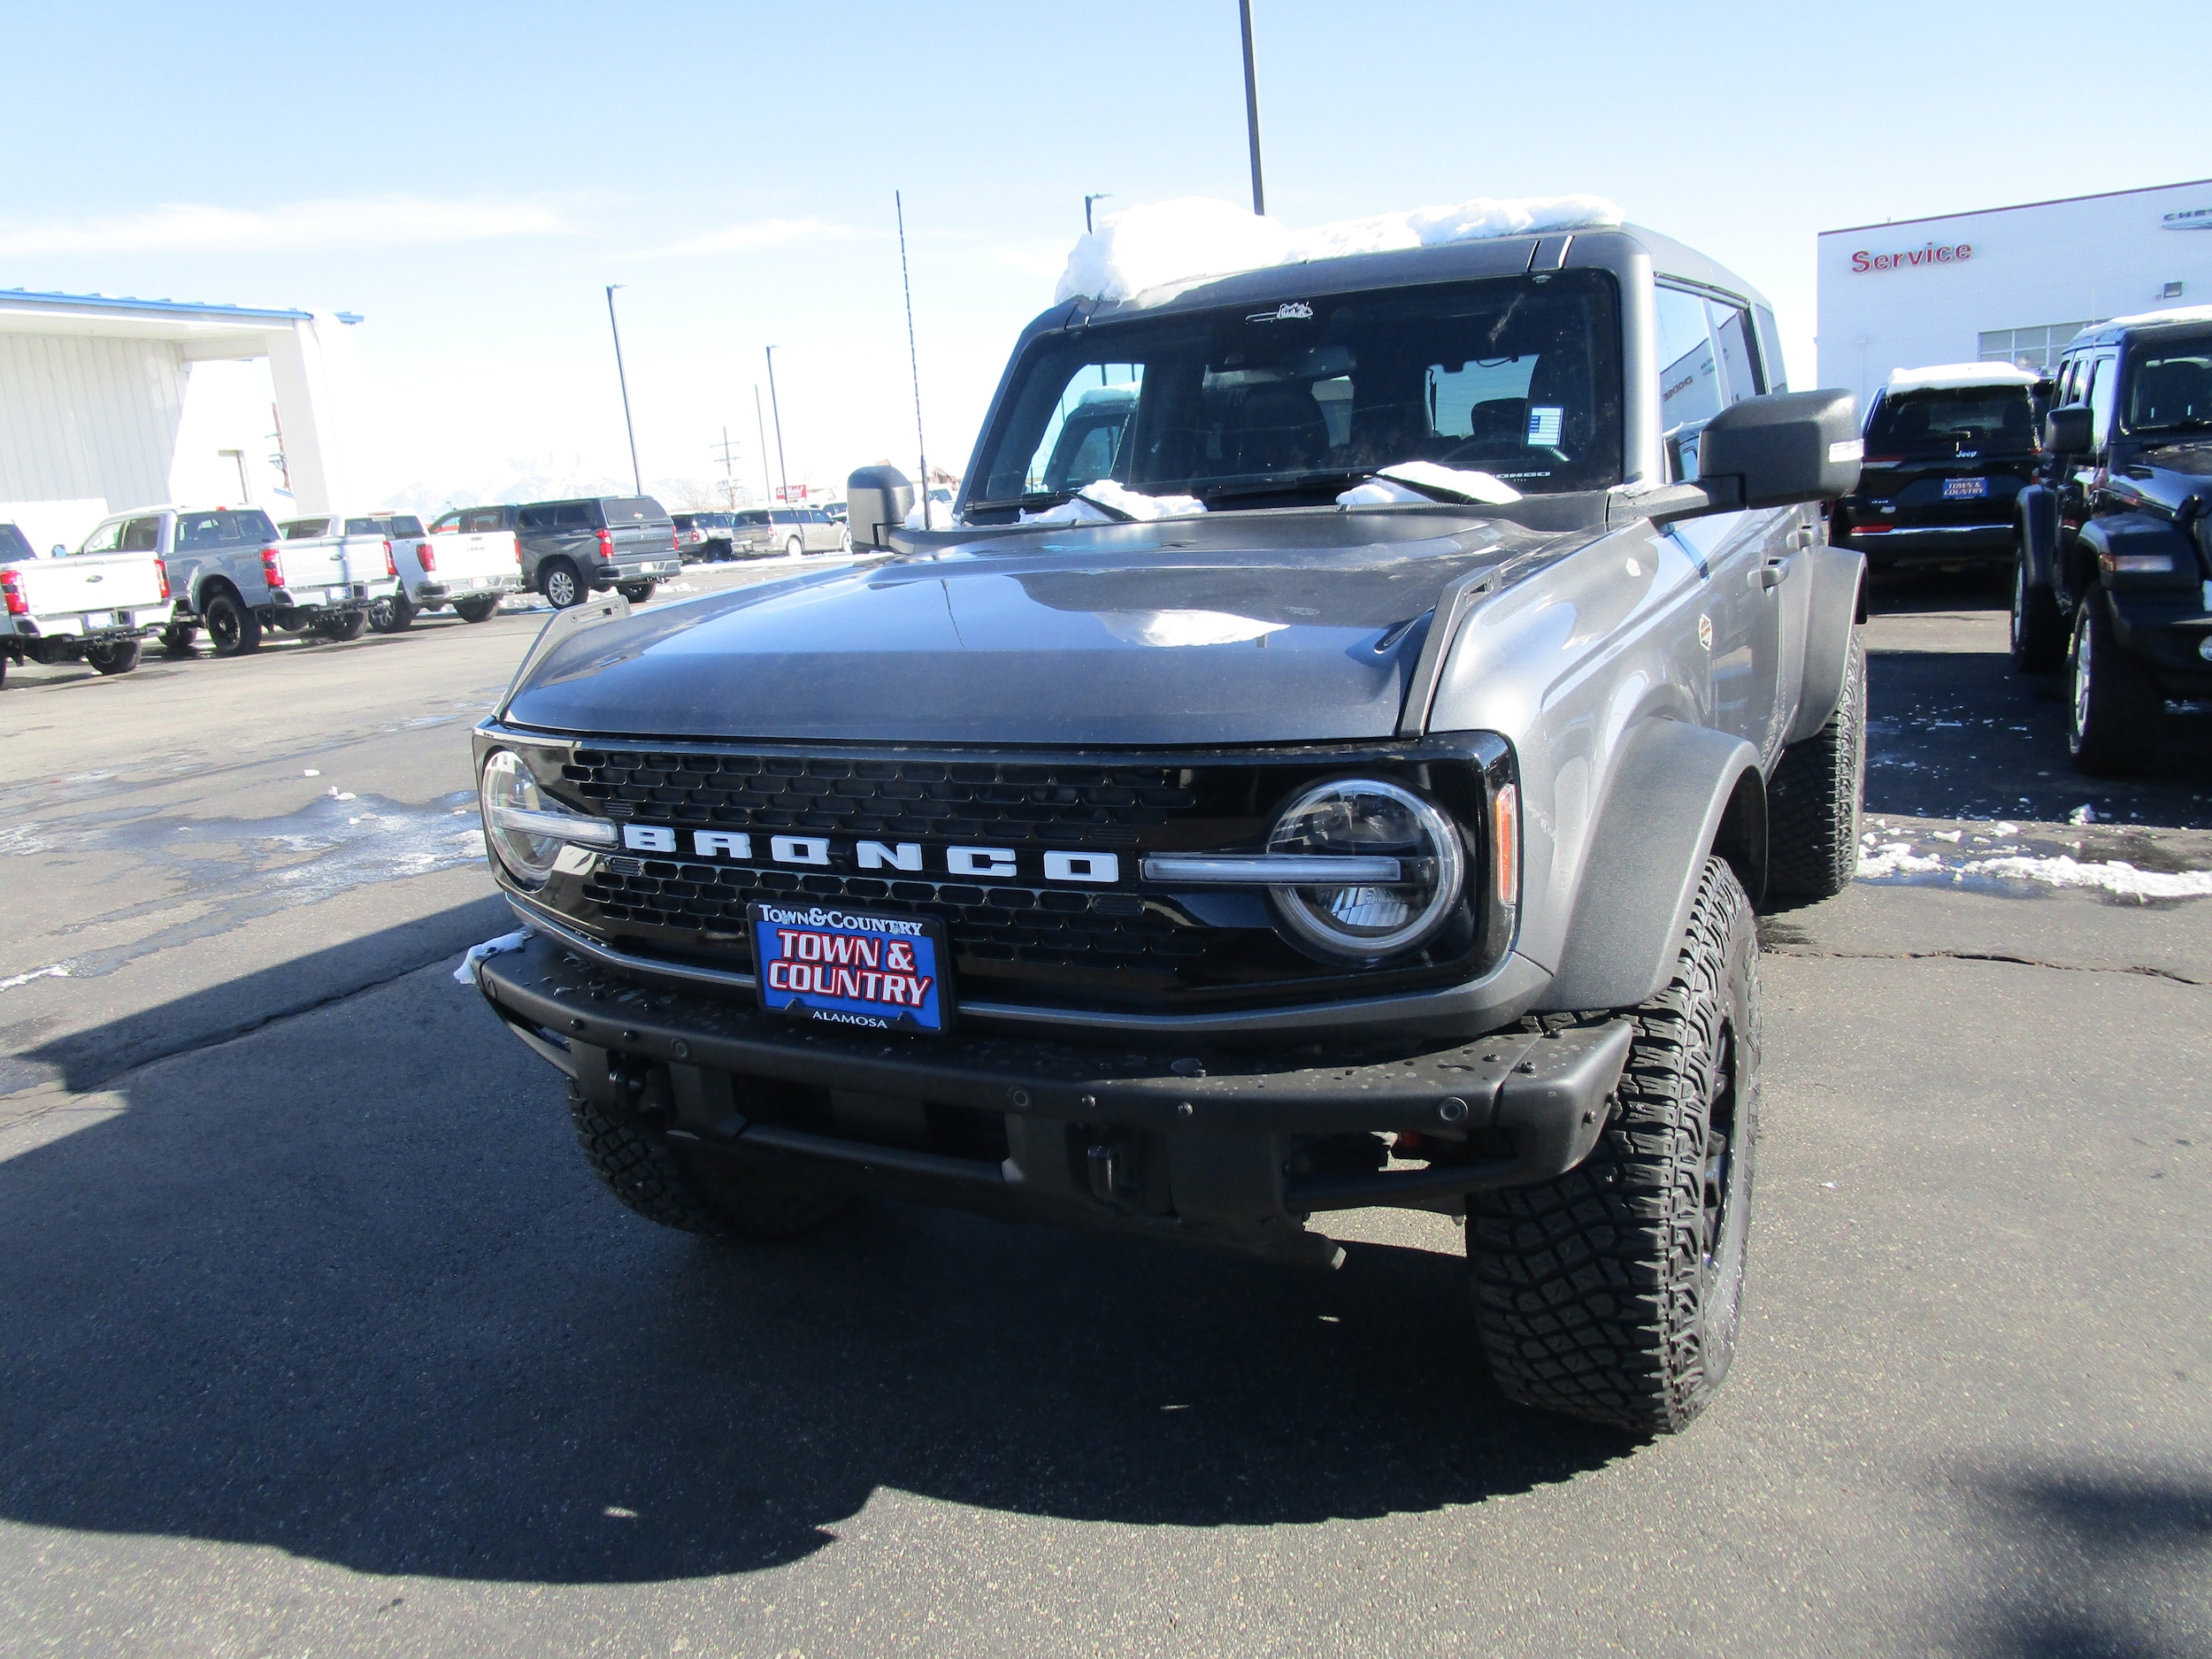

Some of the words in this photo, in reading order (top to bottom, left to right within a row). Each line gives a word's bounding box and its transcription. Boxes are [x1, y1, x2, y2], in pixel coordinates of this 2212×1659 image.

[1851, 242, 1973, 273] Service
[623, 823, 1119, 883] BRONCO
[778, 929, 881, 969] TOWN
[887, 940, 916, 972] &
[768, 960, 931, 1007] COUNTRY
[811, 1010, 888, 1029] ALAMOSA
